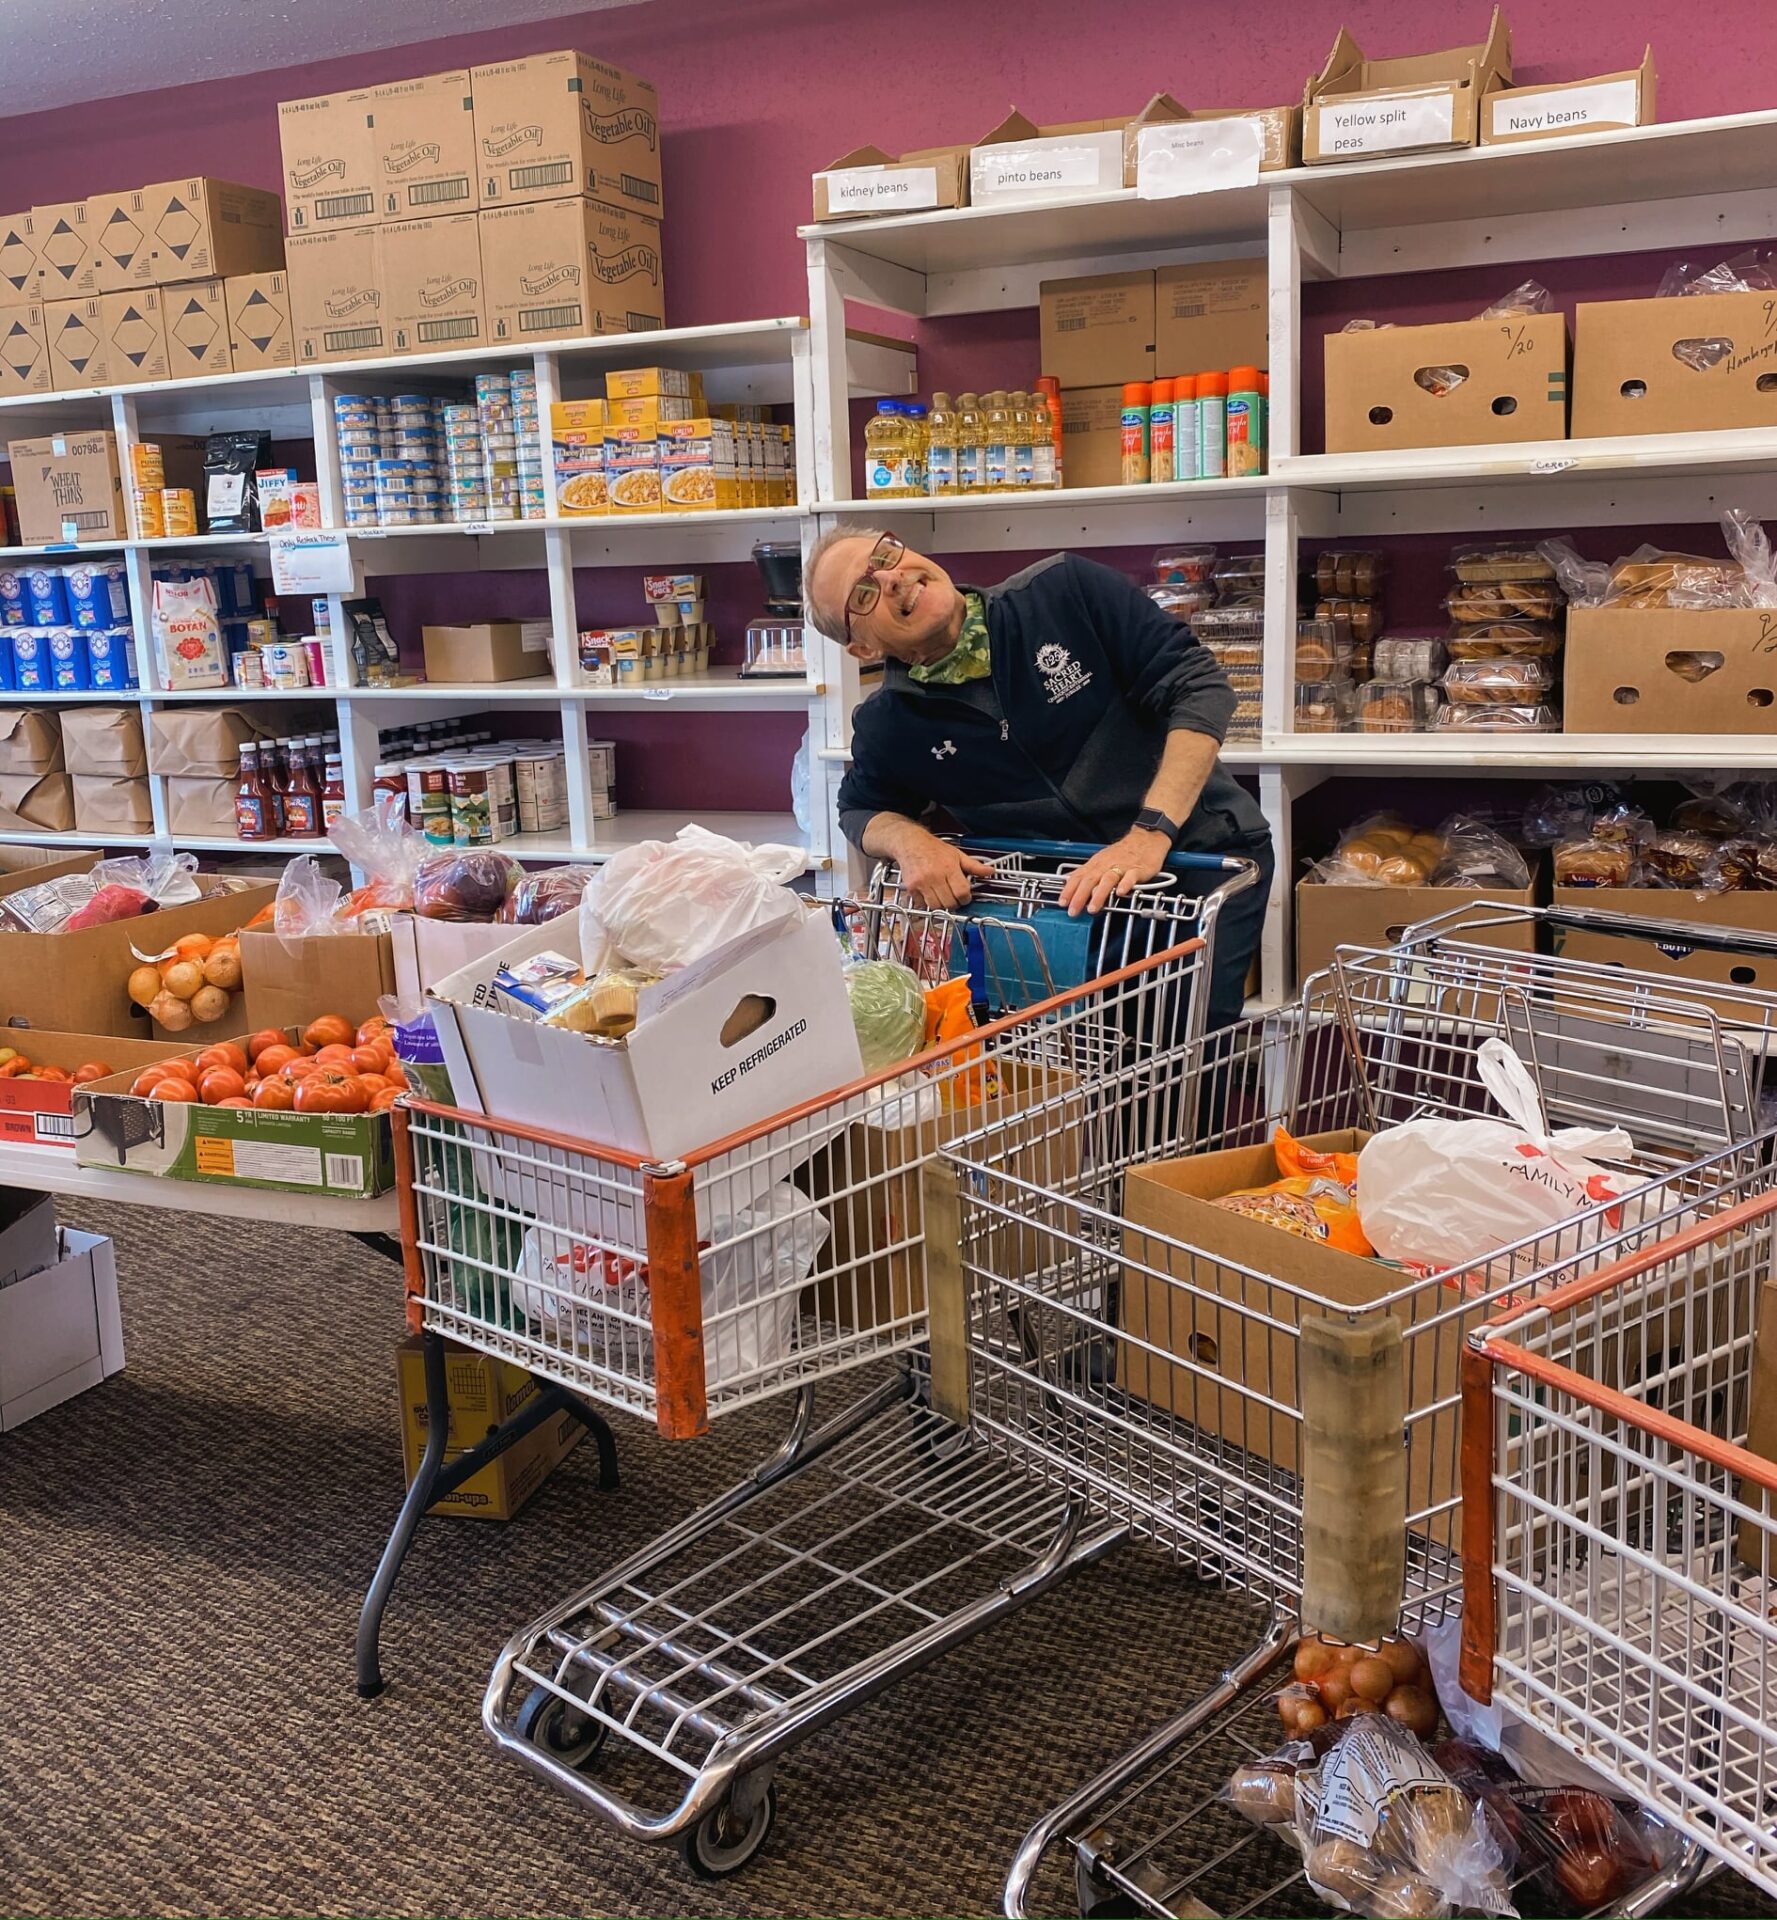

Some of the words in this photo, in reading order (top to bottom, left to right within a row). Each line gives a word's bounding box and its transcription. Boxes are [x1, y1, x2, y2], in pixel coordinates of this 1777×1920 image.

[592, 80, 612, 98] Long
[612, 86, 626, 104] Life
[491, 124, 505, 134] Long
[506, 122, 518, 132] Life
[588, 114, 632, 142] Vegetable
[634, 112, 650, 133] Oil
[1335, 110, 1376, 128] Yellow
[1380, 110, 1406, 124] split
[1510, 116, 1542, 130] Navy
[1546, 108, 1588, 124] beans
[487, 135, 523, 156] Vegetable
[524, 128, 538, 140] Oil
[1185, 139, 1204, 148] beans
[1334, 136, 1364, 152] peas
[297, 156, 310, 166] Long
[387, 152, 420, 172] Vegetable
[293, 168, 327, 188] Vegetable
[998, 170, 1026, 186] pinto
[1029, 168, 1062, 182] beans
[840, 184, 874, 199] kidney
[877, 181, 908, 194] beans
[598, 222, 616, 242] Long
[616, 226, 630, 244] Life
[528, 263, 543, 273] Long
[595, 254, 637, 284] Vegetable
[638, 249, 653, 270] Oil
[524, 275, 560, 294] Vegetable
[562, 268, 576, 280] Oil
[424, 287, 458, 306] Vegetable
[459, 281, 473, 292] Oil
[329, 298, 362, 317] Vegetable
[1762, 300, 1777, 338] 9/
[1501, 325, 1534, 360] 9/20
[72, 444, 98, 456] 00798
[50, 472, 80, 488] WHEAT
[258, 478, 286, 489] JIFFY
[648, 580, 672, 590] Snack
[170, 620, 208, 634] BOTAN
[586, 635, 610, 646] Snack
[1044, 651, 1060, 668] 125
[1044, 661, 1080, 690] SACRED
[1050, 669, 1082, 695] HEART
[711, 1067, 738, 1094] KEEP
[738, 1018, 808, 1076] REFRIGERATED
[236, 1110, 244, 1124] 5
[258, 1112, 279, 1122] LIMITED
[280, 1114, 310, 1124] WARRANTY
